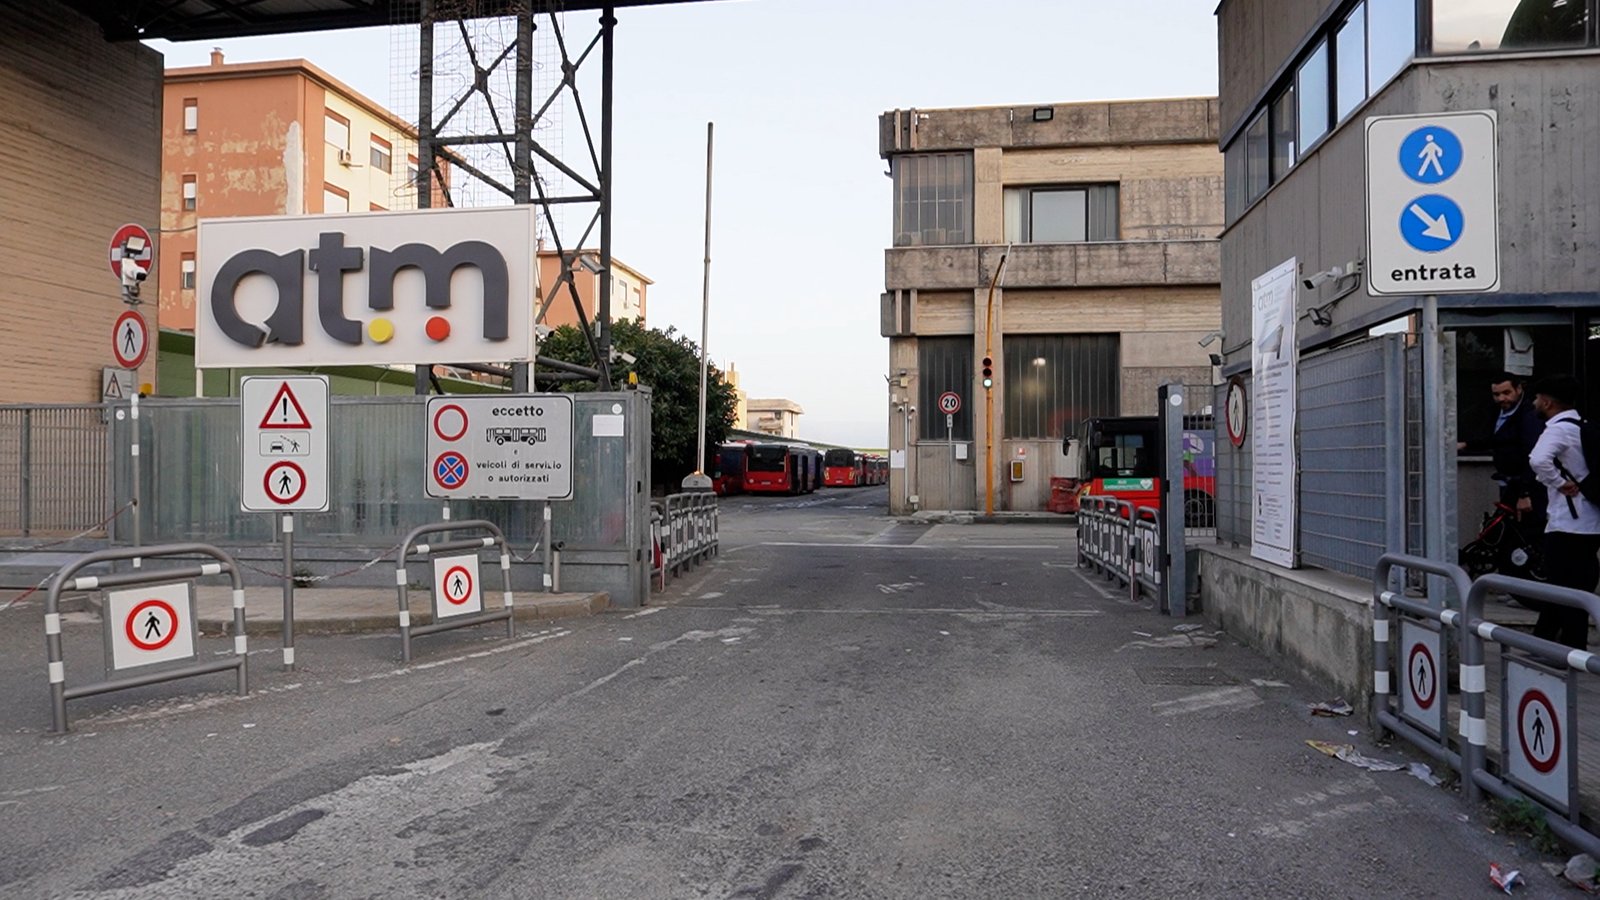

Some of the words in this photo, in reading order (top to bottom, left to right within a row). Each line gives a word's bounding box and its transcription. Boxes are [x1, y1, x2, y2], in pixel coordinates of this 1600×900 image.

[1391, 263, 1476, 281] entrata
[211, 232, 509, 348] atm
[944, 398, 956, 408] 20
[492, 405, 544, 416] eccetto
[476, 460, 507, 469] veicoli
[511, 460, 519, 469] di
[499, 474, 549, 482] autorizzati
